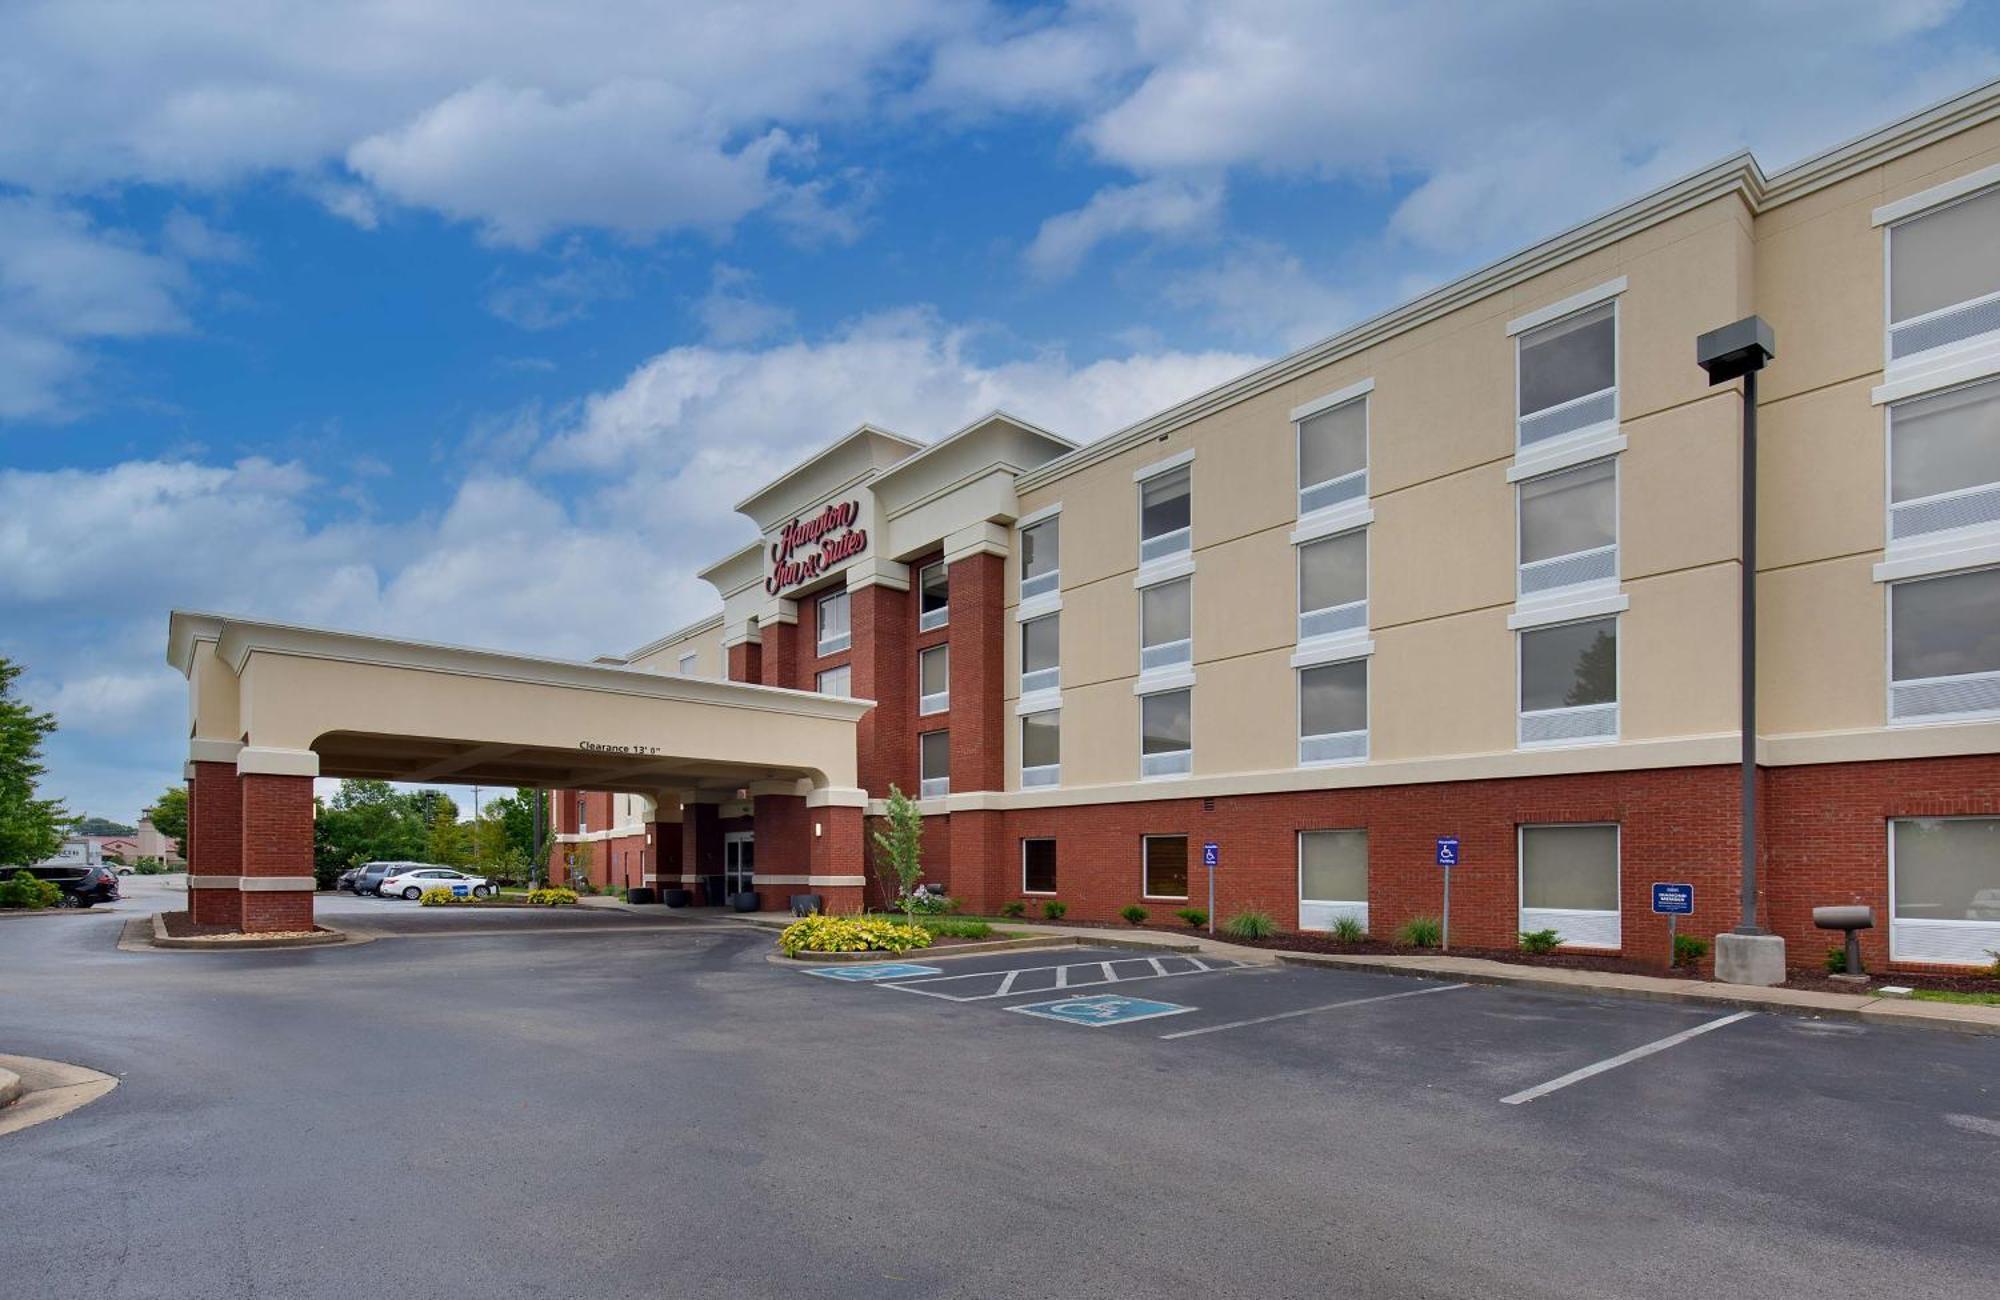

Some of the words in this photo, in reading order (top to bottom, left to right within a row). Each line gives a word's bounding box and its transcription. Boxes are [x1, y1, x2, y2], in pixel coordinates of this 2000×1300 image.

[771, 500, 859, 562] Hampton
[765, 560, 805, 596] Inn
[816, 529, 868, 572] Suites
[579, 740, 629, 753] Clearance
